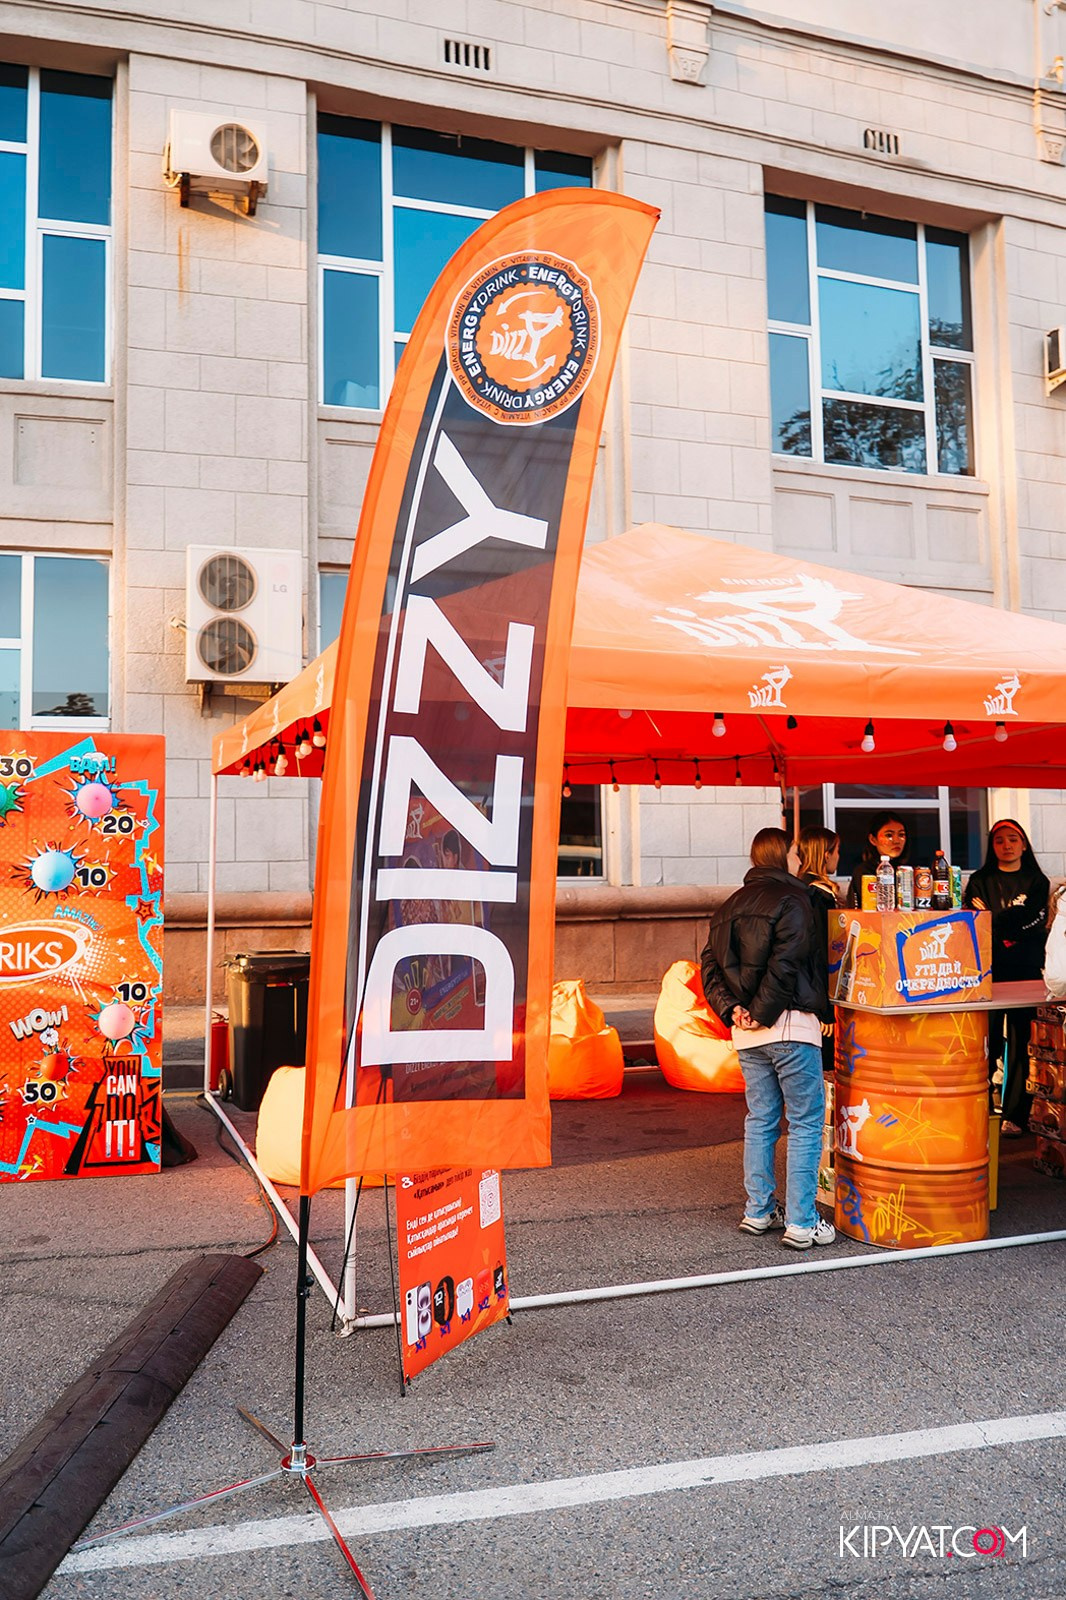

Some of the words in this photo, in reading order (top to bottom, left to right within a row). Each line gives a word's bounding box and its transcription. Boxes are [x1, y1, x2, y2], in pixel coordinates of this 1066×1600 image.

[273, 584, 287, 593] LG
[720, 577, 797, 587] ENERGY
[360, 429, 549, 1067] DIZZY
[0, 758, 31, 777] 30
[70, 755, 116, 775] BAM!
[103, 815, 133, 834] 20
[76, 868, 106, 886] 10
[118, 982, 146, 1002] 10
[896, 975, 981, 993] ОЧЕРЕДНОСТЬ
[9, 1005, 69, 1041] WOW!
[24, 1082, 56, 1102] 50
[107, 1075, 137, 1096] CAN
[107, 1093, 135, 1121] DO
[106, 1119, 136, 1158] IT!
